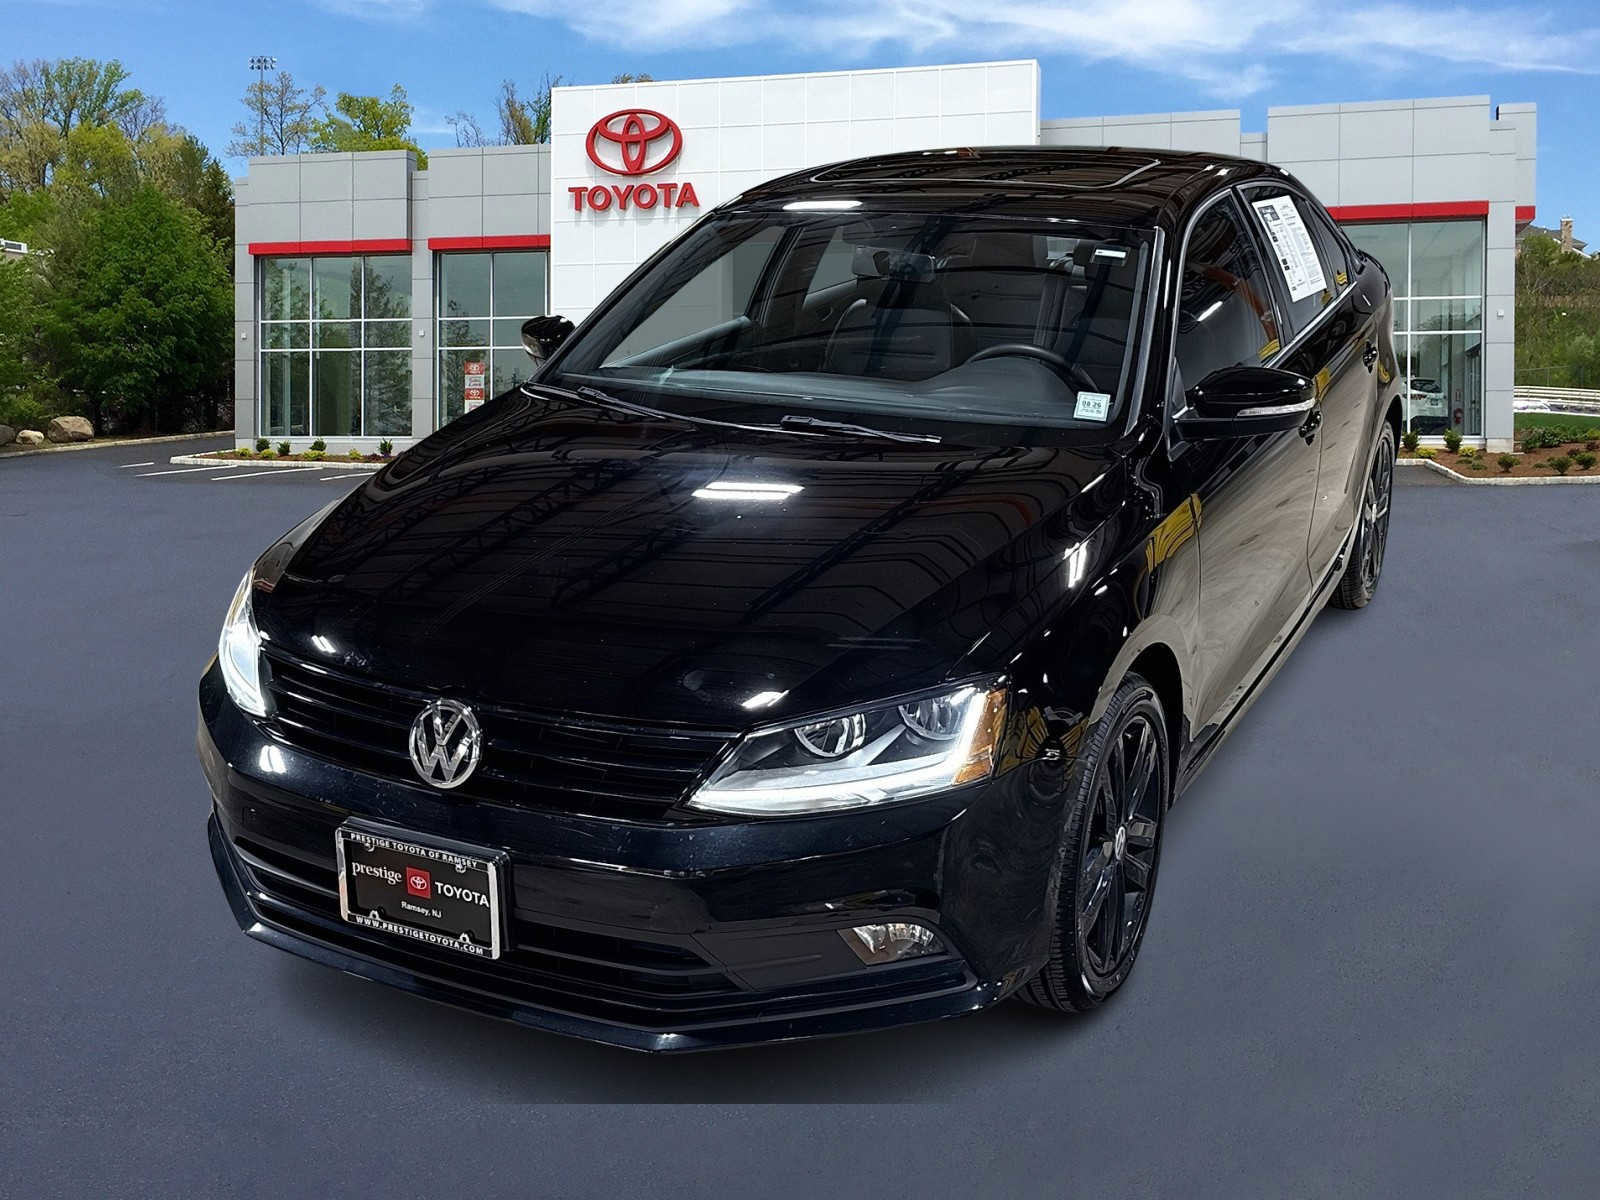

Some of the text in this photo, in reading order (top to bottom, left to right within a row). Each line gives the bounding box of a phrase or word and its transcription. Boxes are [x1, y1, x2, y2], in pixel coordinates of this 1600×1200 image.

[568, 182, 700, 211] TOYOTA
[351, 833, 477, 868] PRESTIGE TOYOTA OF RAMSEY
[352, 862, 402, 885] prestige
[434, 882, 490, 908] TOYOTA
[401, 901, 442, 918] Ramsey, NJ
[356, 915, 483, 956] WWW.PRESTIGETOYOTA.COM
